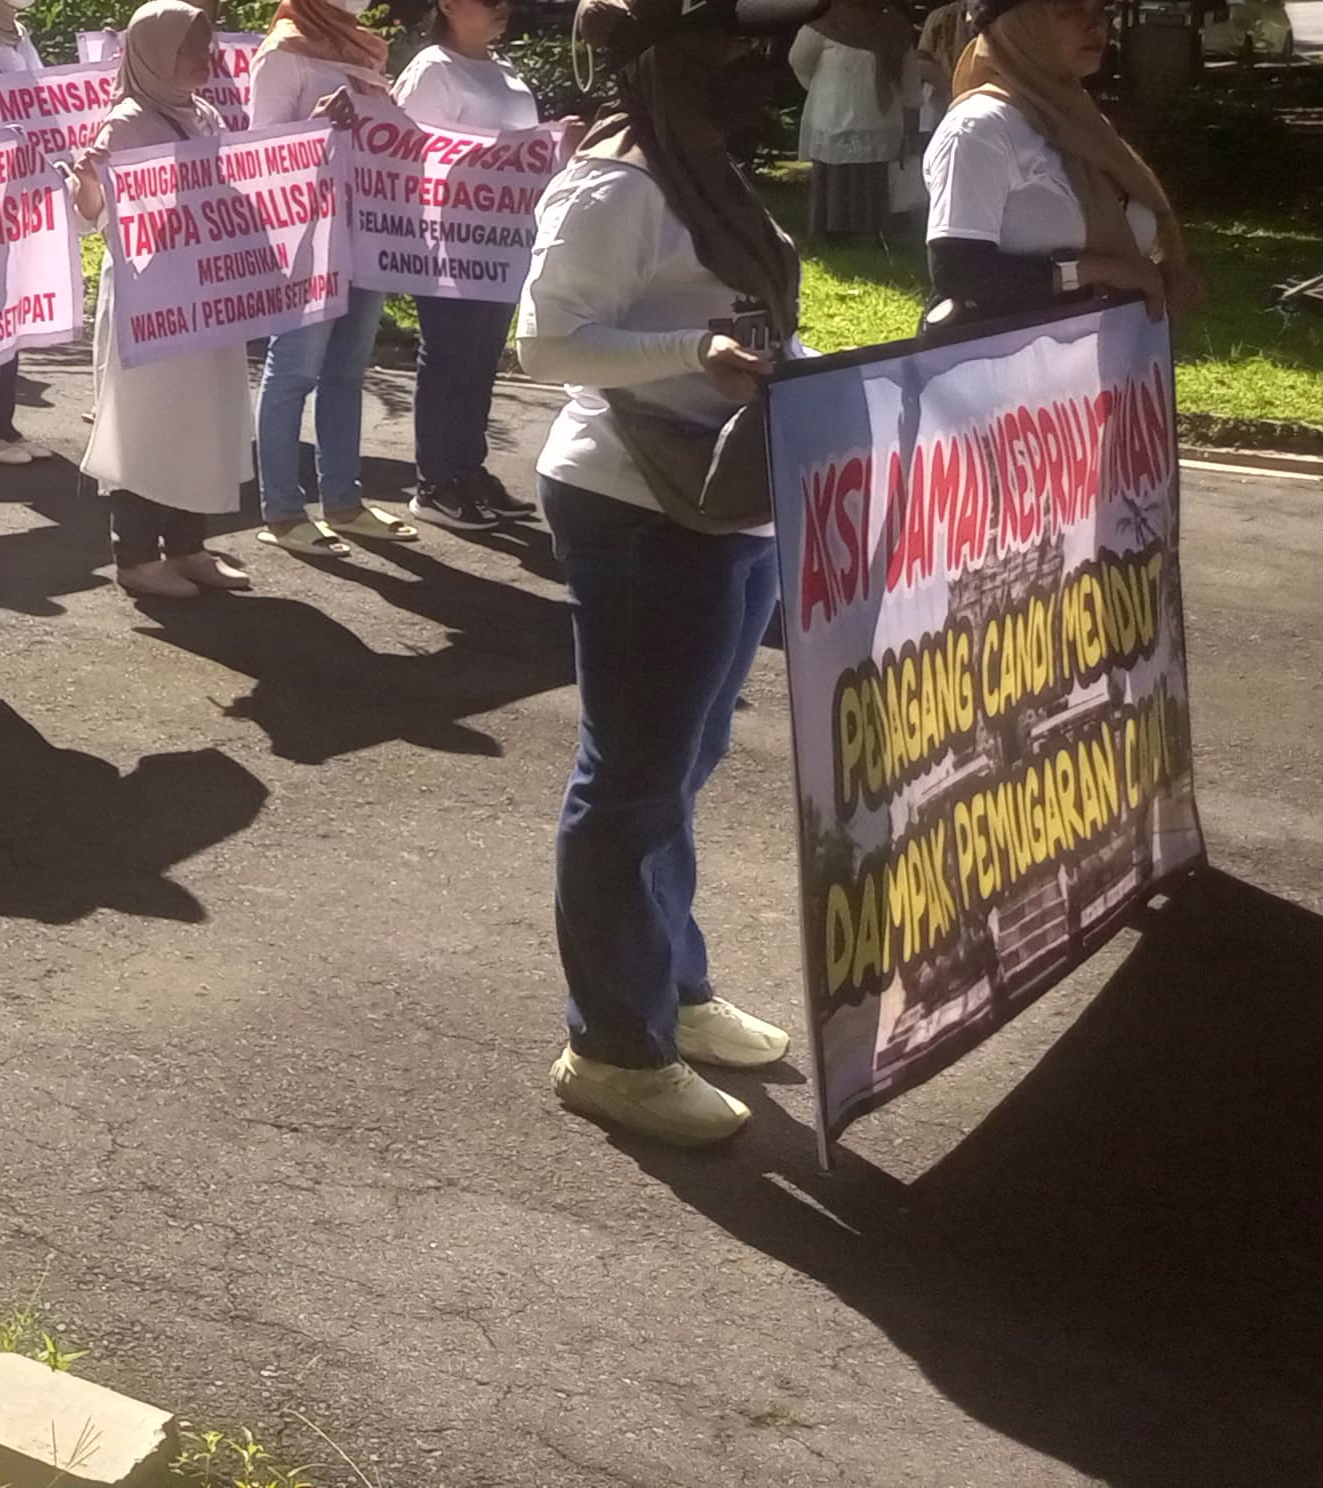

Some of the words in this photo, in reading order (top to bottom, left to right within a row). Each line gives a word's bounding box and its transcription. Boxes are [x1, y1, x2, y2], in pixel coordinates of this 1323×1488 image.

[27, 123, 97, 154] PEDAGA
[116, 158, 213, 203] PEMUGARAN
[216, 149, 260, 185] CANDI
[264, 137, 329, 177] MENDUT
[119, 205, 201, 258] TANPA
[201, 177, 337, 242] SOSIALISASI
[354, 167, 400, 201] UAT
[405, 175, 545, 215] PEDAGAN
[197, 242, 289, 287] MERUGIKAN
[378, 249, 429, 276] CANDI
[433, 257, 511, 283] MENDUT
[419, 221, 539, 249] PEMUGARAN
[130, 307, 189, 344] WARGA
[202, 287, 283, 329] PEDAGANG
[285, 271, 340, 311] SETEMPAT
[801, 455, 874, 633] AKSI
[886, 423, 990, 595] DAMAI
[839, 629, 974, 804] PEDAGANG
[981, 596, 1056, 718] CANDI
[1061, 552, 1163, 684] MENDUT
[825, 818, 955, 996] DAMPAK
[954, 721, 1119, 912] PEMUGARAN
